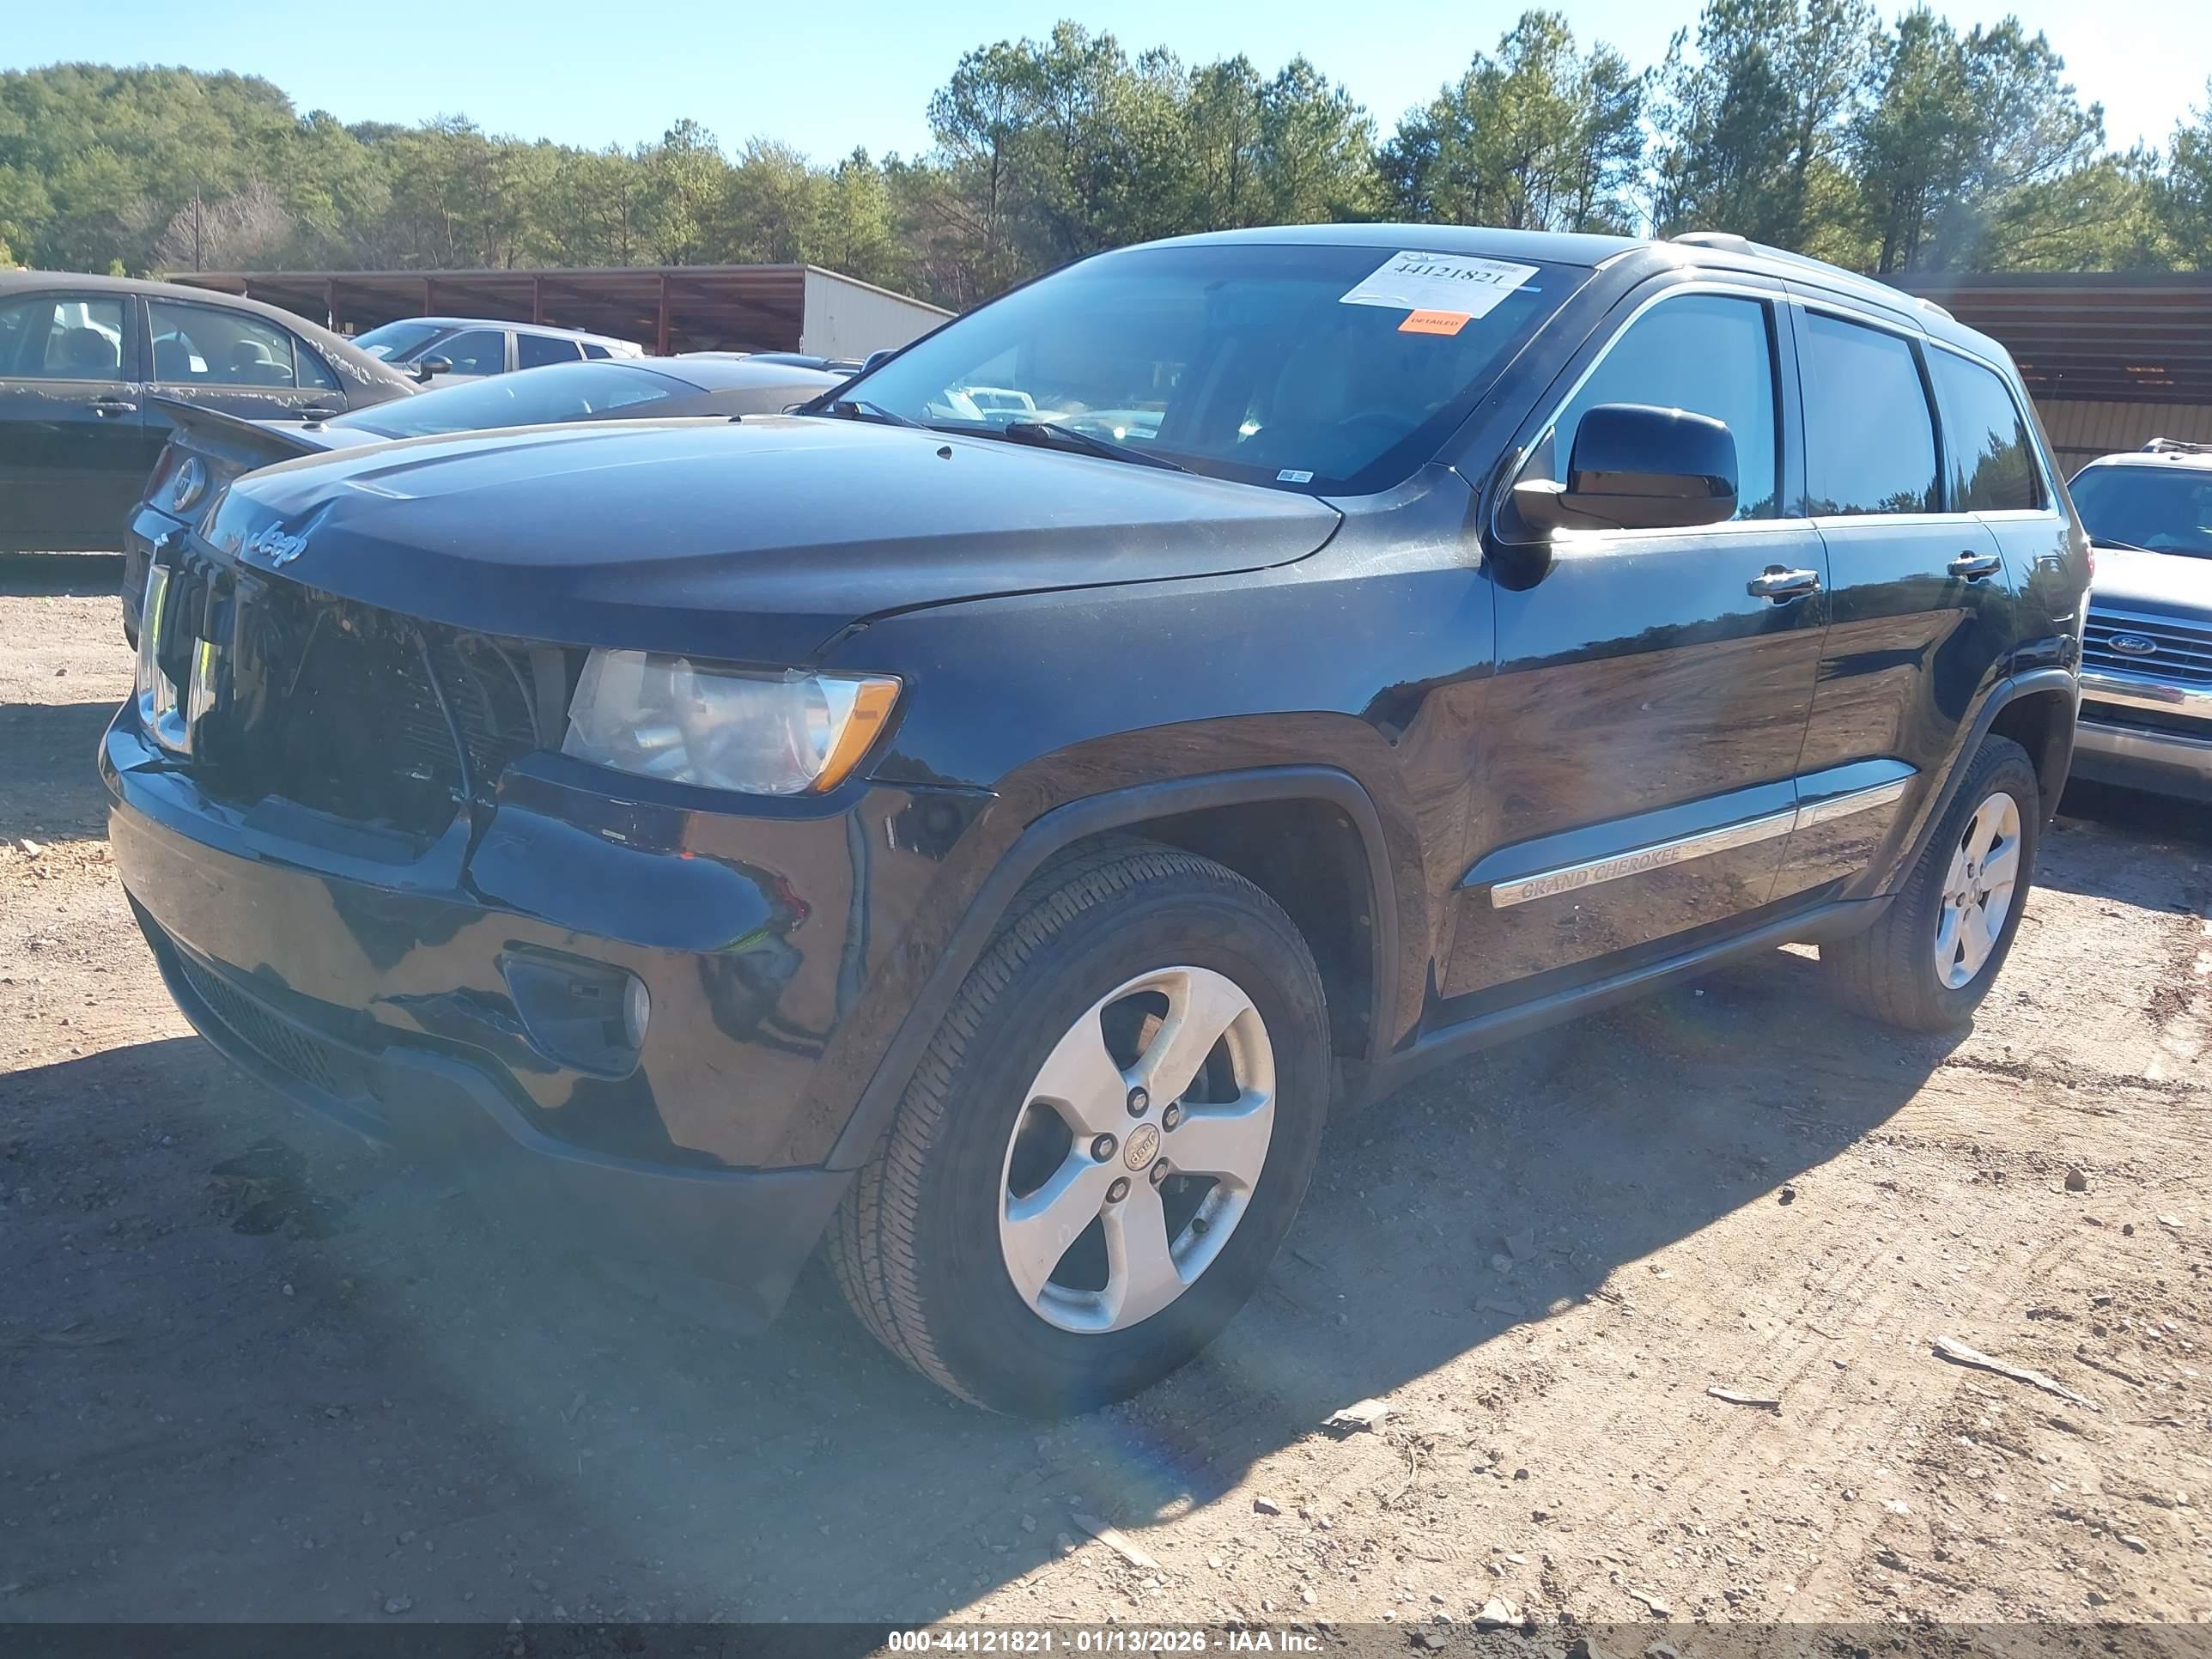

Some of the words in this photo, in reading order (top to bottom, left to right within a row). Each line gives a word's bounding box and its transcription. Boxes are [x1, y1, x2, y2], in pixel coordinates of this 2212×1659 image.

[1394, 263, 1505, 284] 44121821
[248, 520, 308, 568] Jeep
[2118, 637, 2147, 650] Ford
[1521, 869, 1589, 899] GRAND
[1593, 848, 1680, 880] CHEROKEE
[1131, 1132, 1157, 1164] Jeep
